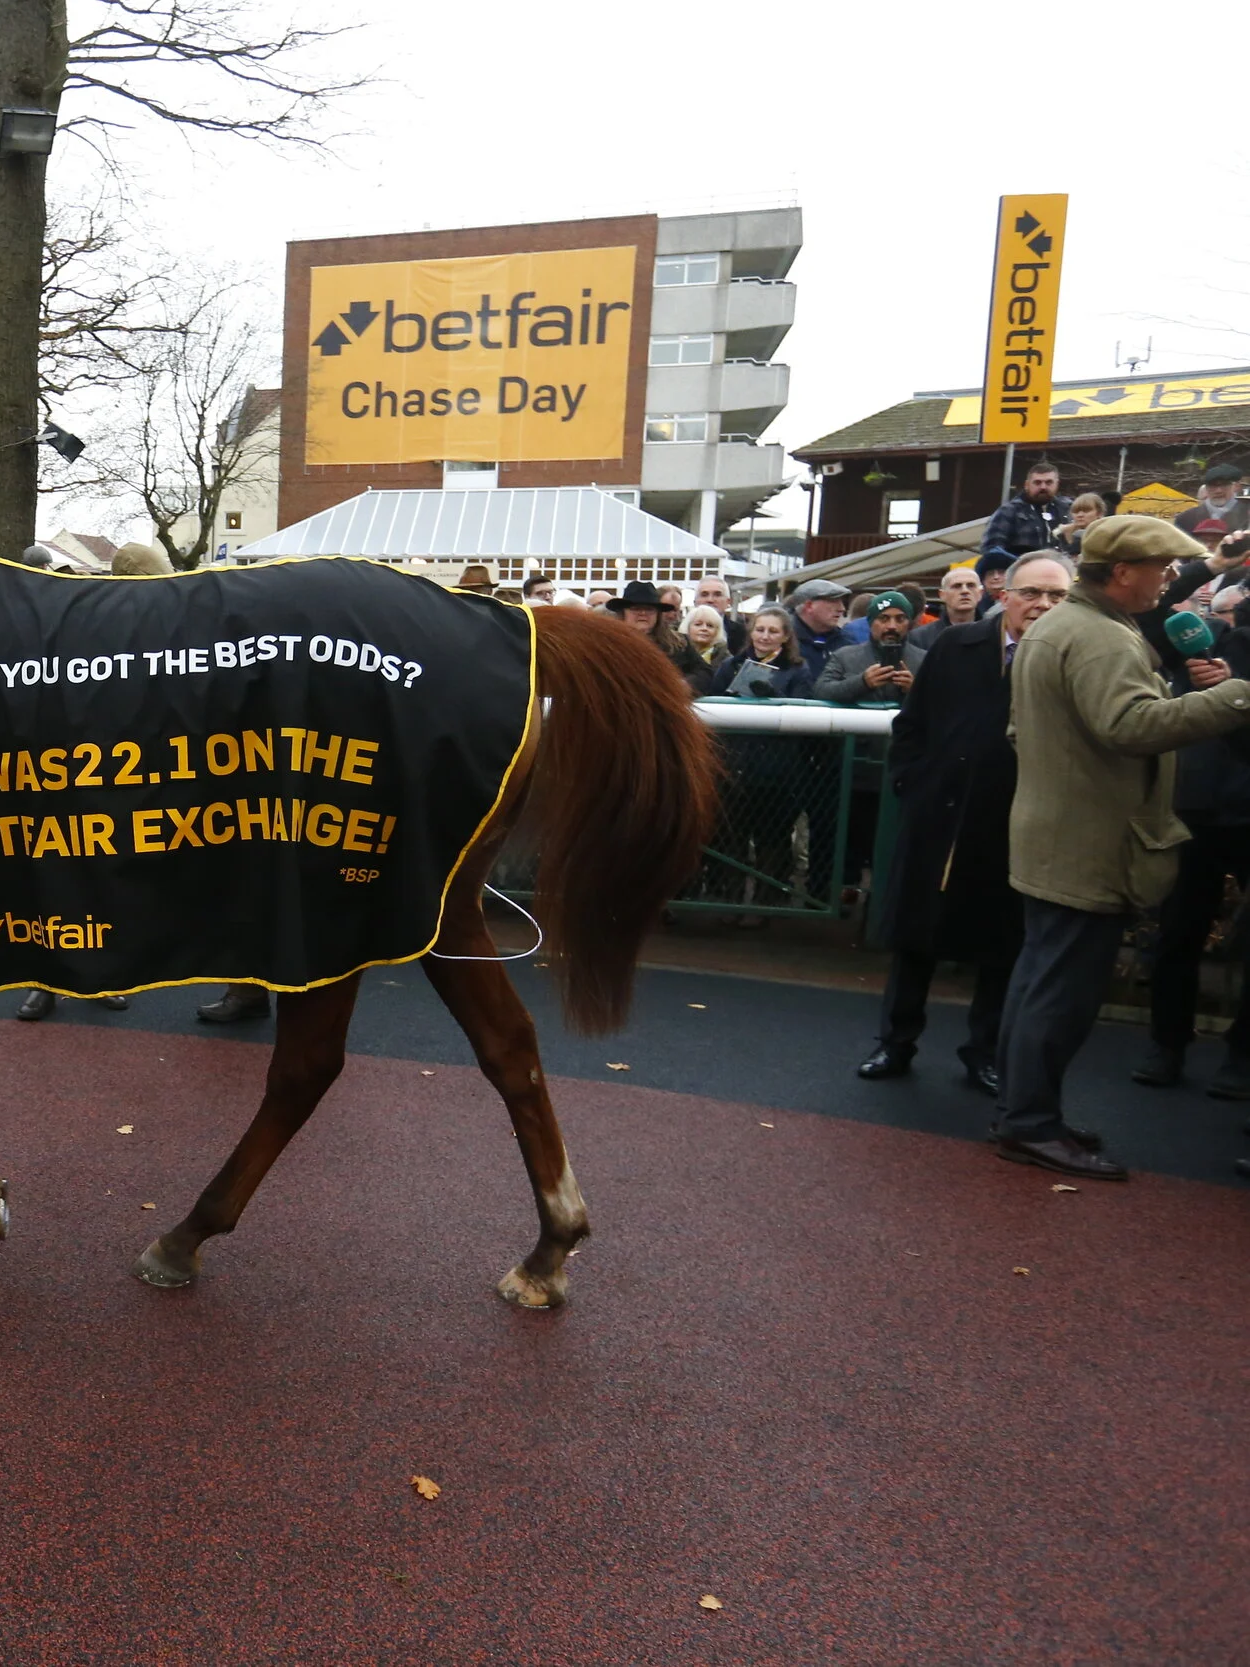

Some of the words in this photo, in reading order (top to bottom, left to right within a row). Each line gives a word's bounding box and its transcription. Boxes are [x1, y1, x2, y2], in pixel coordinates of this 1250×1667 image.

[383, 288, 630, 353] betfair
[1000, 262, 1051, 428] betfair
[341, 380, 481, 419] Chase
[497, 376, 587, 421] Day
[0, 656, 59, 688] YOU
[66, 653, 135, 684] GOT
[143, 648, 209, 676] THE
[214, 635, 303, 668] BEST
[308, 634, 423, 689] ODDS?
[205, 728, 274, 776] ON
[280, 727, 380, 785] THE
[132, 797, 397, 854] EXCHANGE!
[4, 911, 113, 950] betfair
